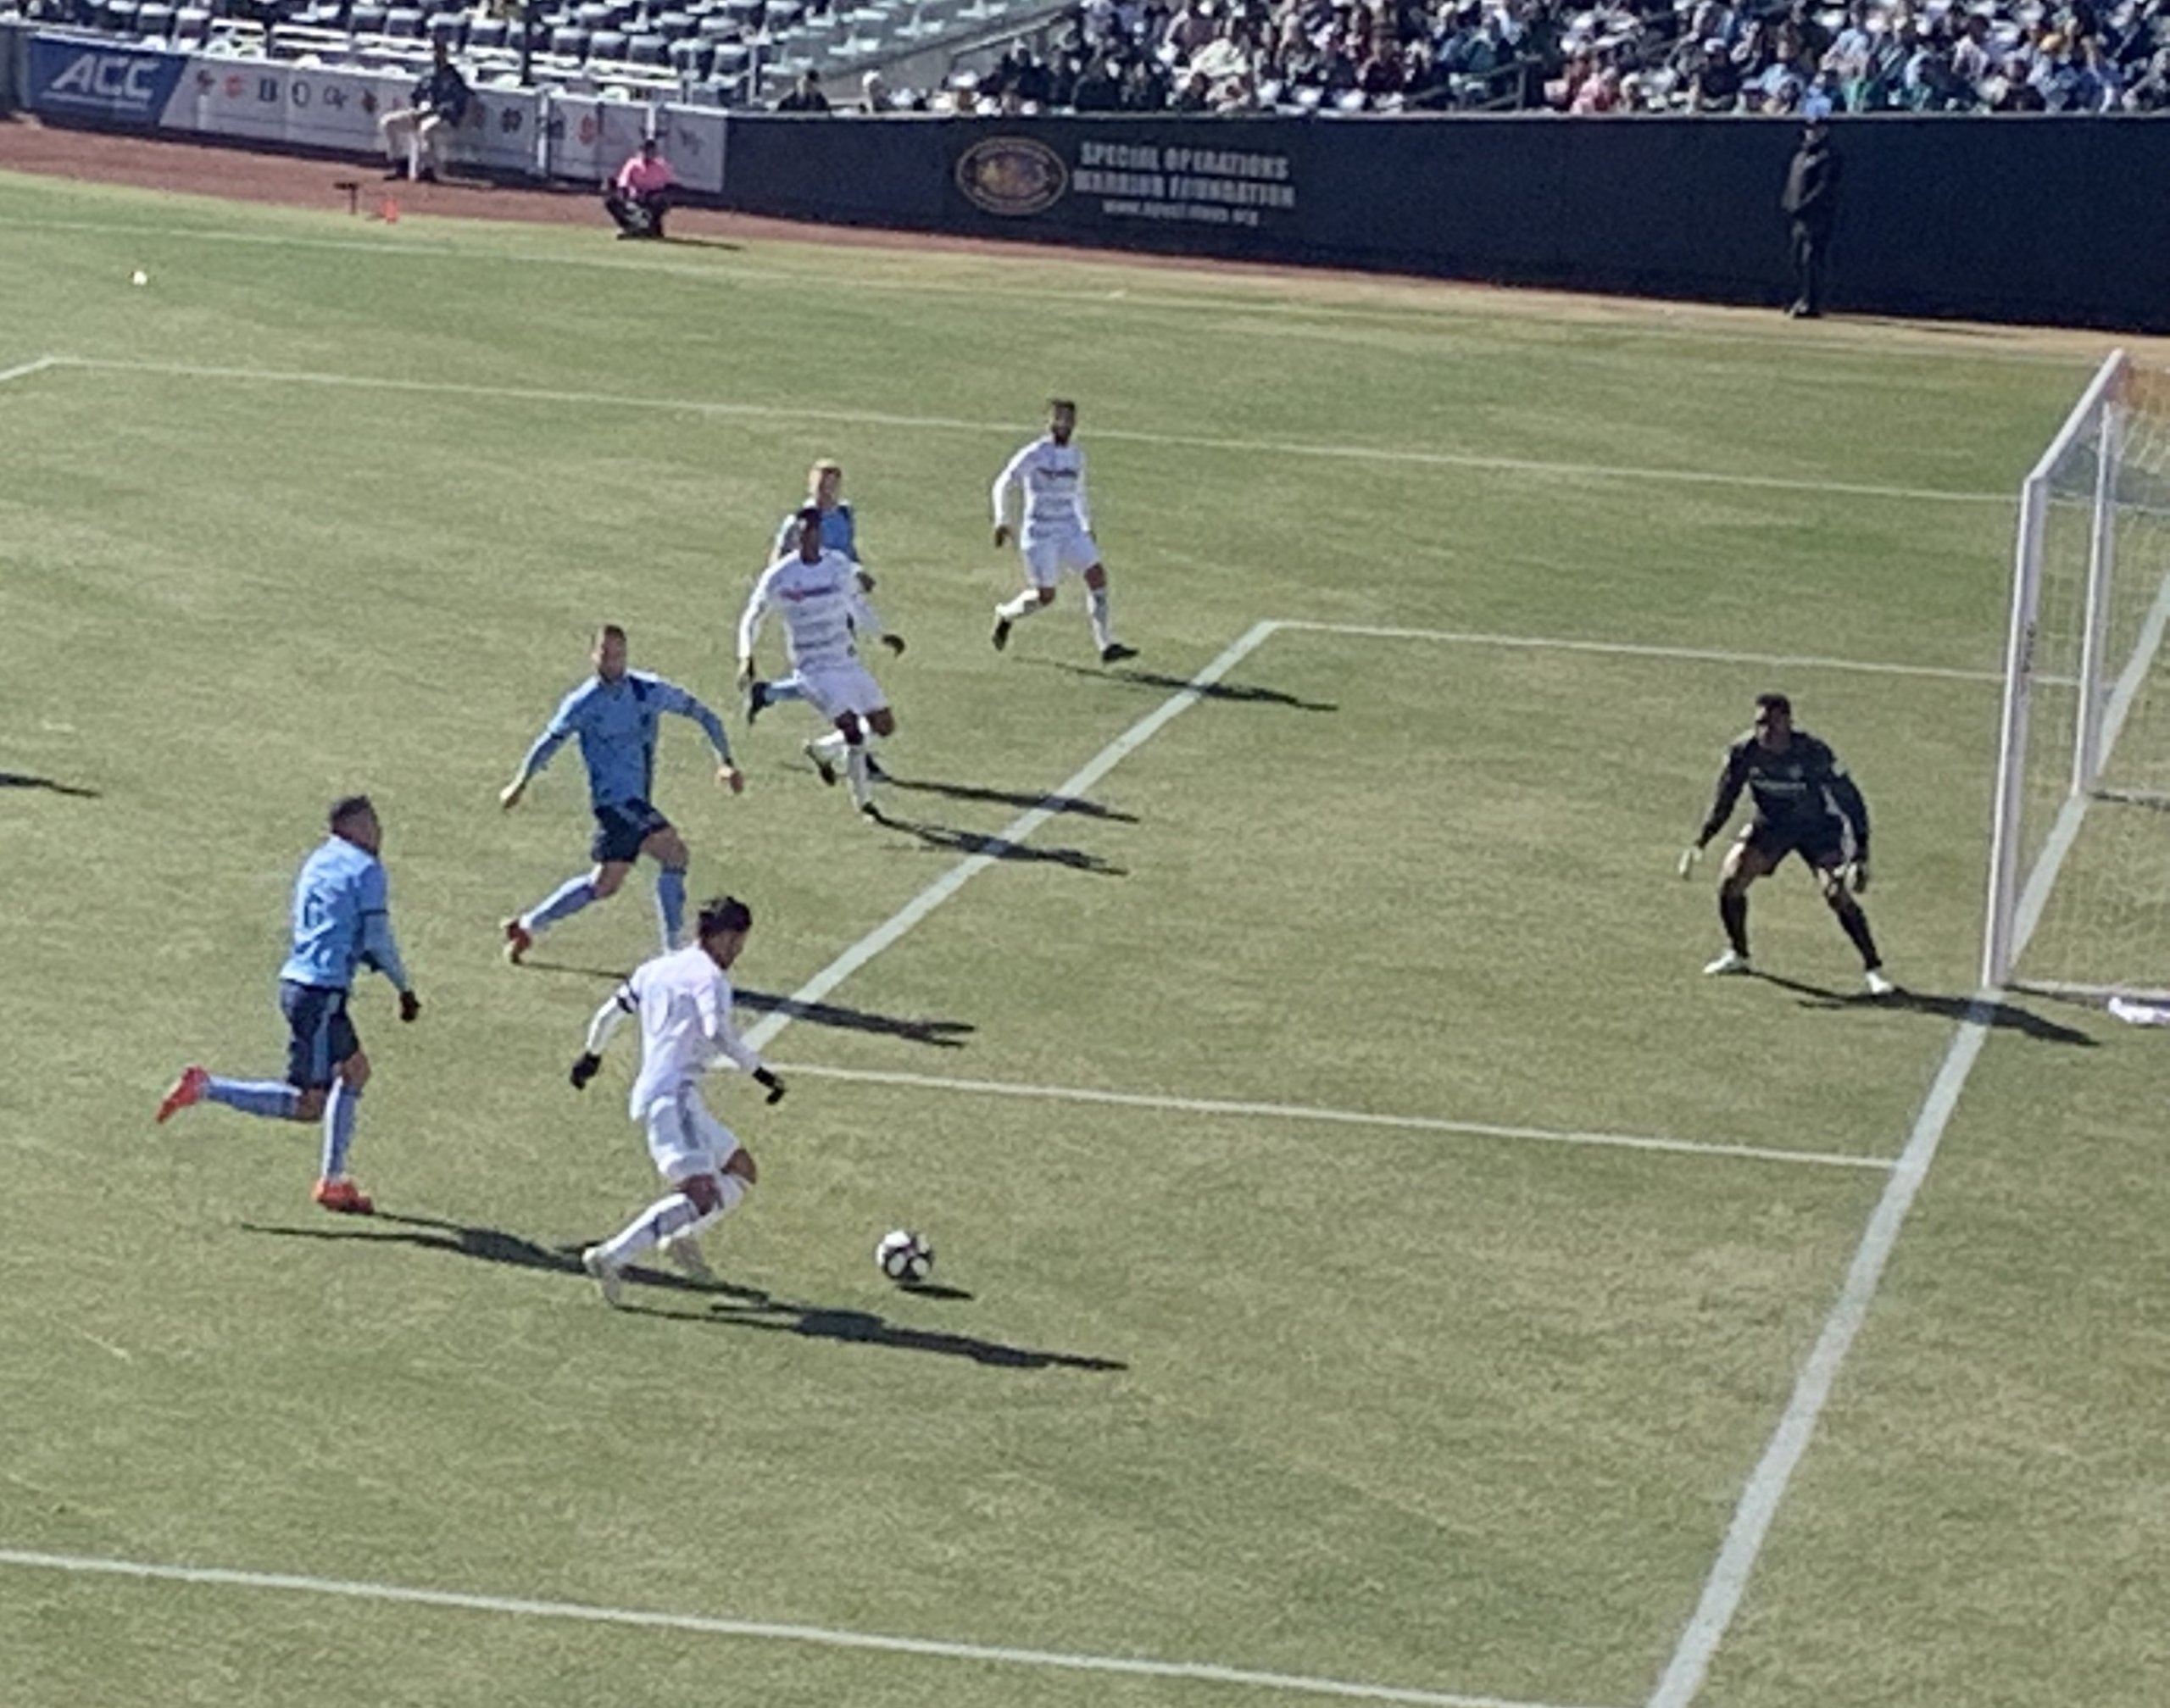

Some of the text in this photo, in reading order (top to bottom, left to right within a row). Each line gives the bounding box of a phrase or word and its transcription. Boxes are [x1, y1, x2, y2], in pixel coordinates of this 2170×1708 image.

[51, 53, 160, 100] ACC
[1080, 142, 1289, 181] SPECIAL OPERATIONS
[1072, 170, 1165, 198] WARRIOR
[1169, 174, 1295, 208] FOUNDATION
